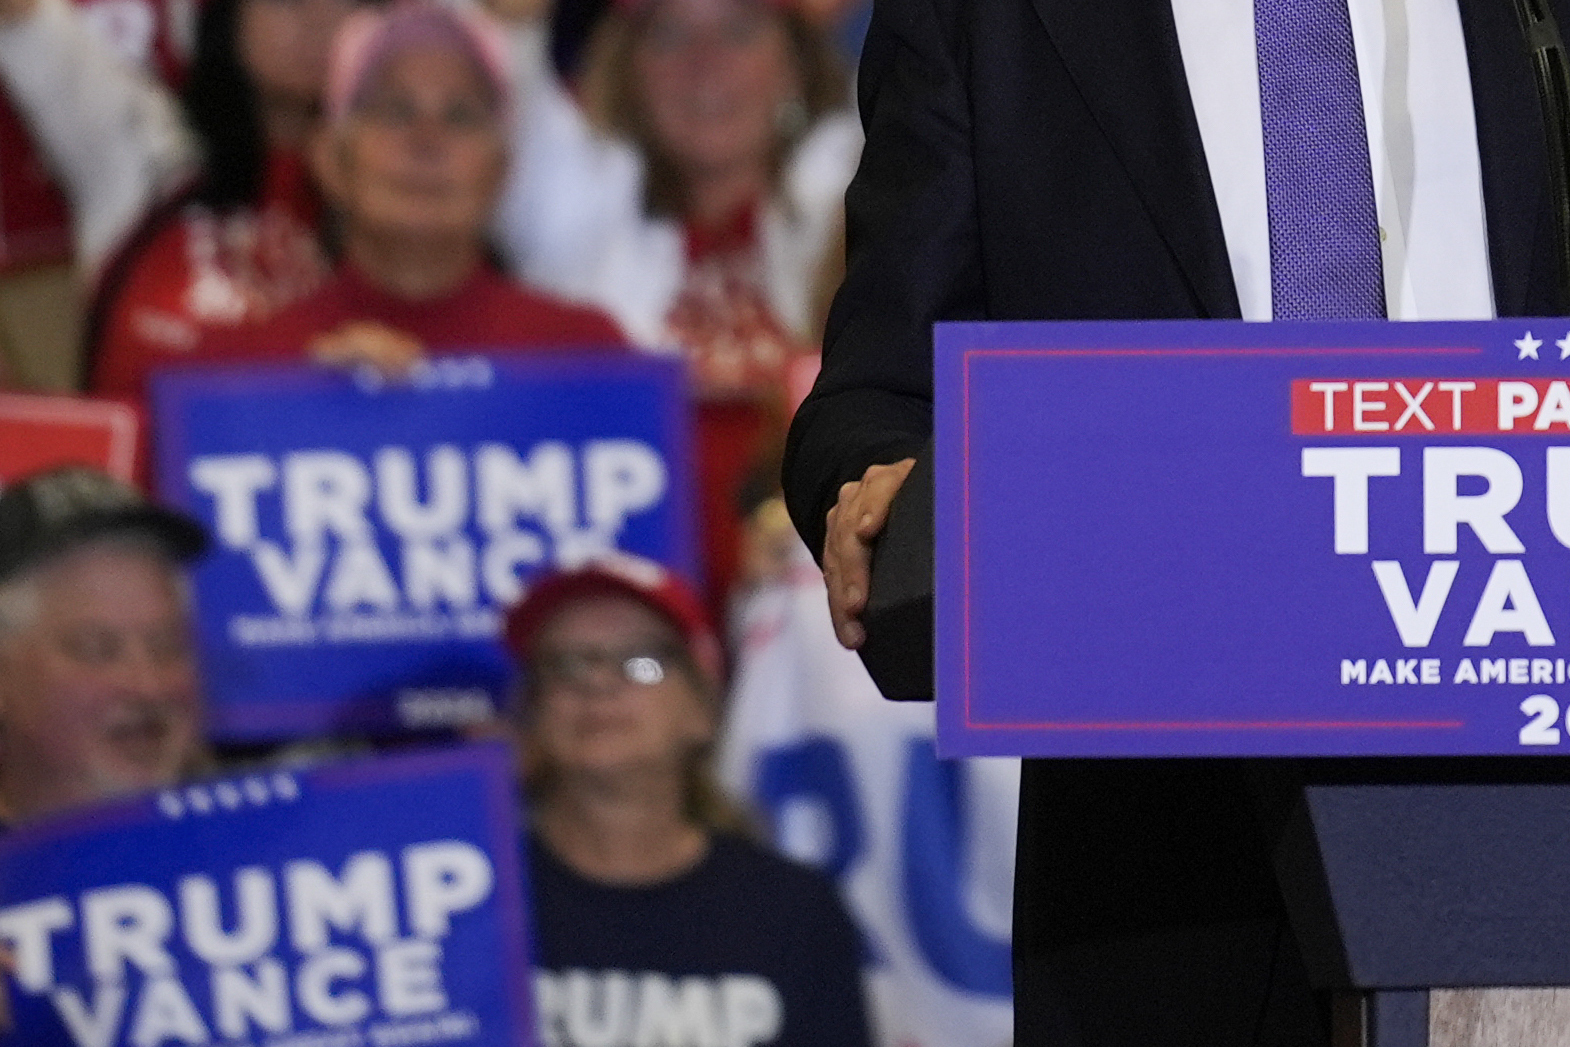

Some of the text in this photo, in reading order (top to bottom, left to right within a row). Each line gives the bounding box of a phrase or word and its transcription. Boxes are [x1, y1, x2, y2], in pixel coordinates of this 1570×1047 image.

[1309, 381, 1477, 432] TEXT
[190, 438, 667, 550] TRUMP
[253, 529, 628, 616] VANC
[1340, 659, 1441, 685] MAKE
[0, 840, 495, 995] TRUMP
[52, 937, 449, 1047] VANCE
